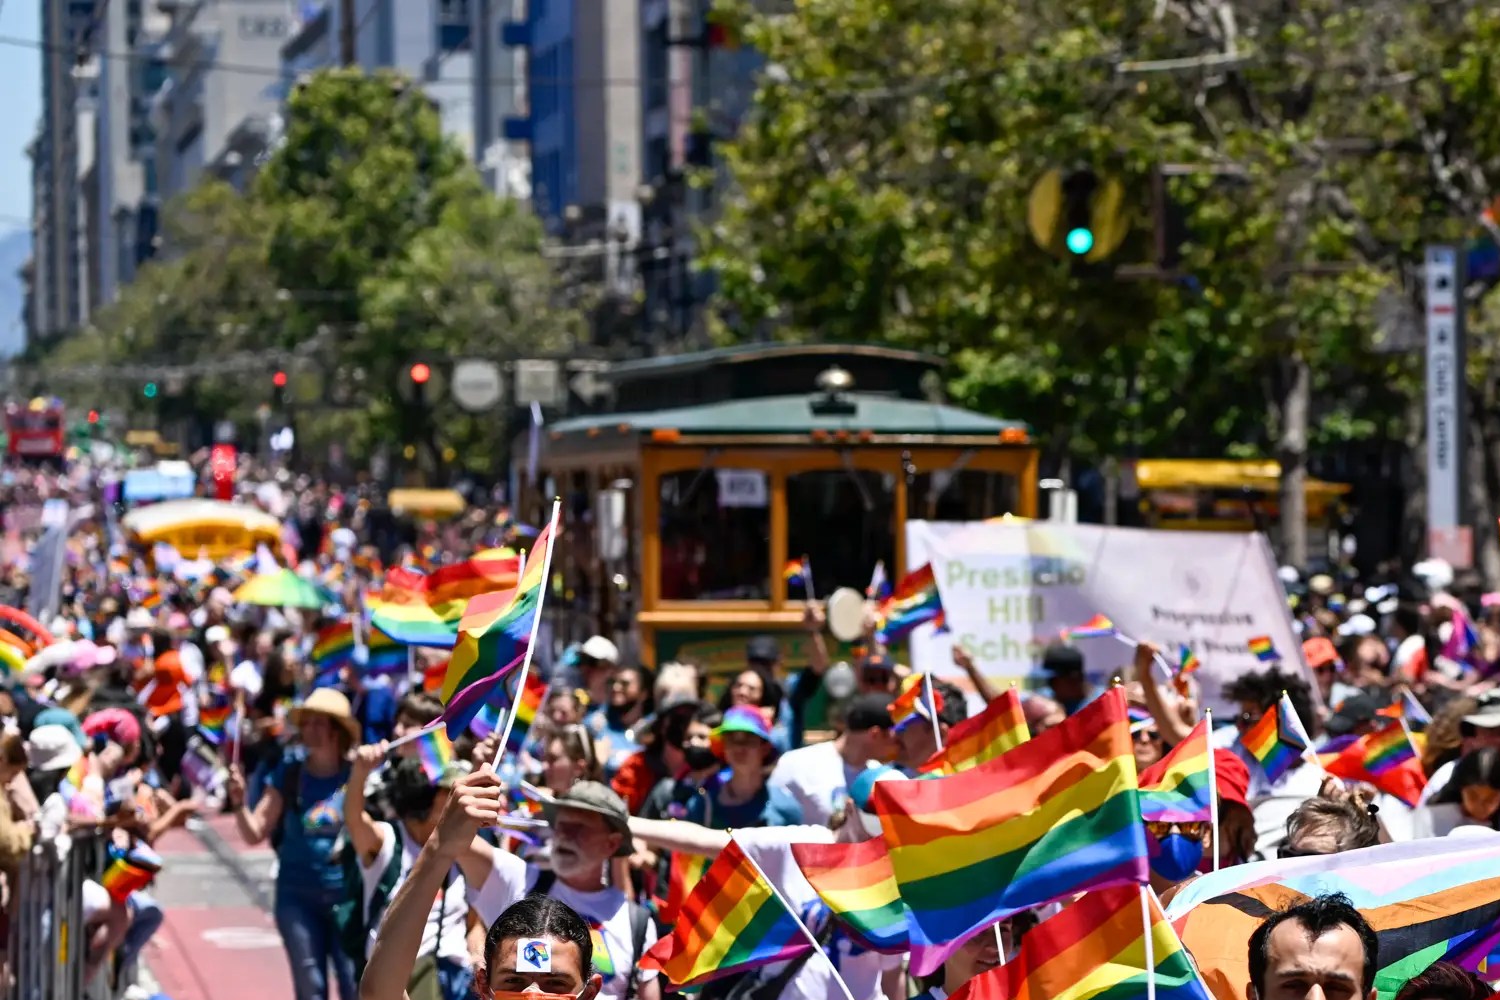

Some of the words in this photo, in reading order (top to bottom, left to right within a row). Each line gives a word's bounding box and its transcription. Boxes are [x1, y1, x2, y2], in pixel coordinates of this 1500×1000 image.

[1434, 352, 1449, 396] Civic
[1434, 405, 1449, 470] Center
[946, 558, 1086, 588] Presidio
[987, 594, 1044, 624] Hill
[959, 632, 1046, 662] Scho
